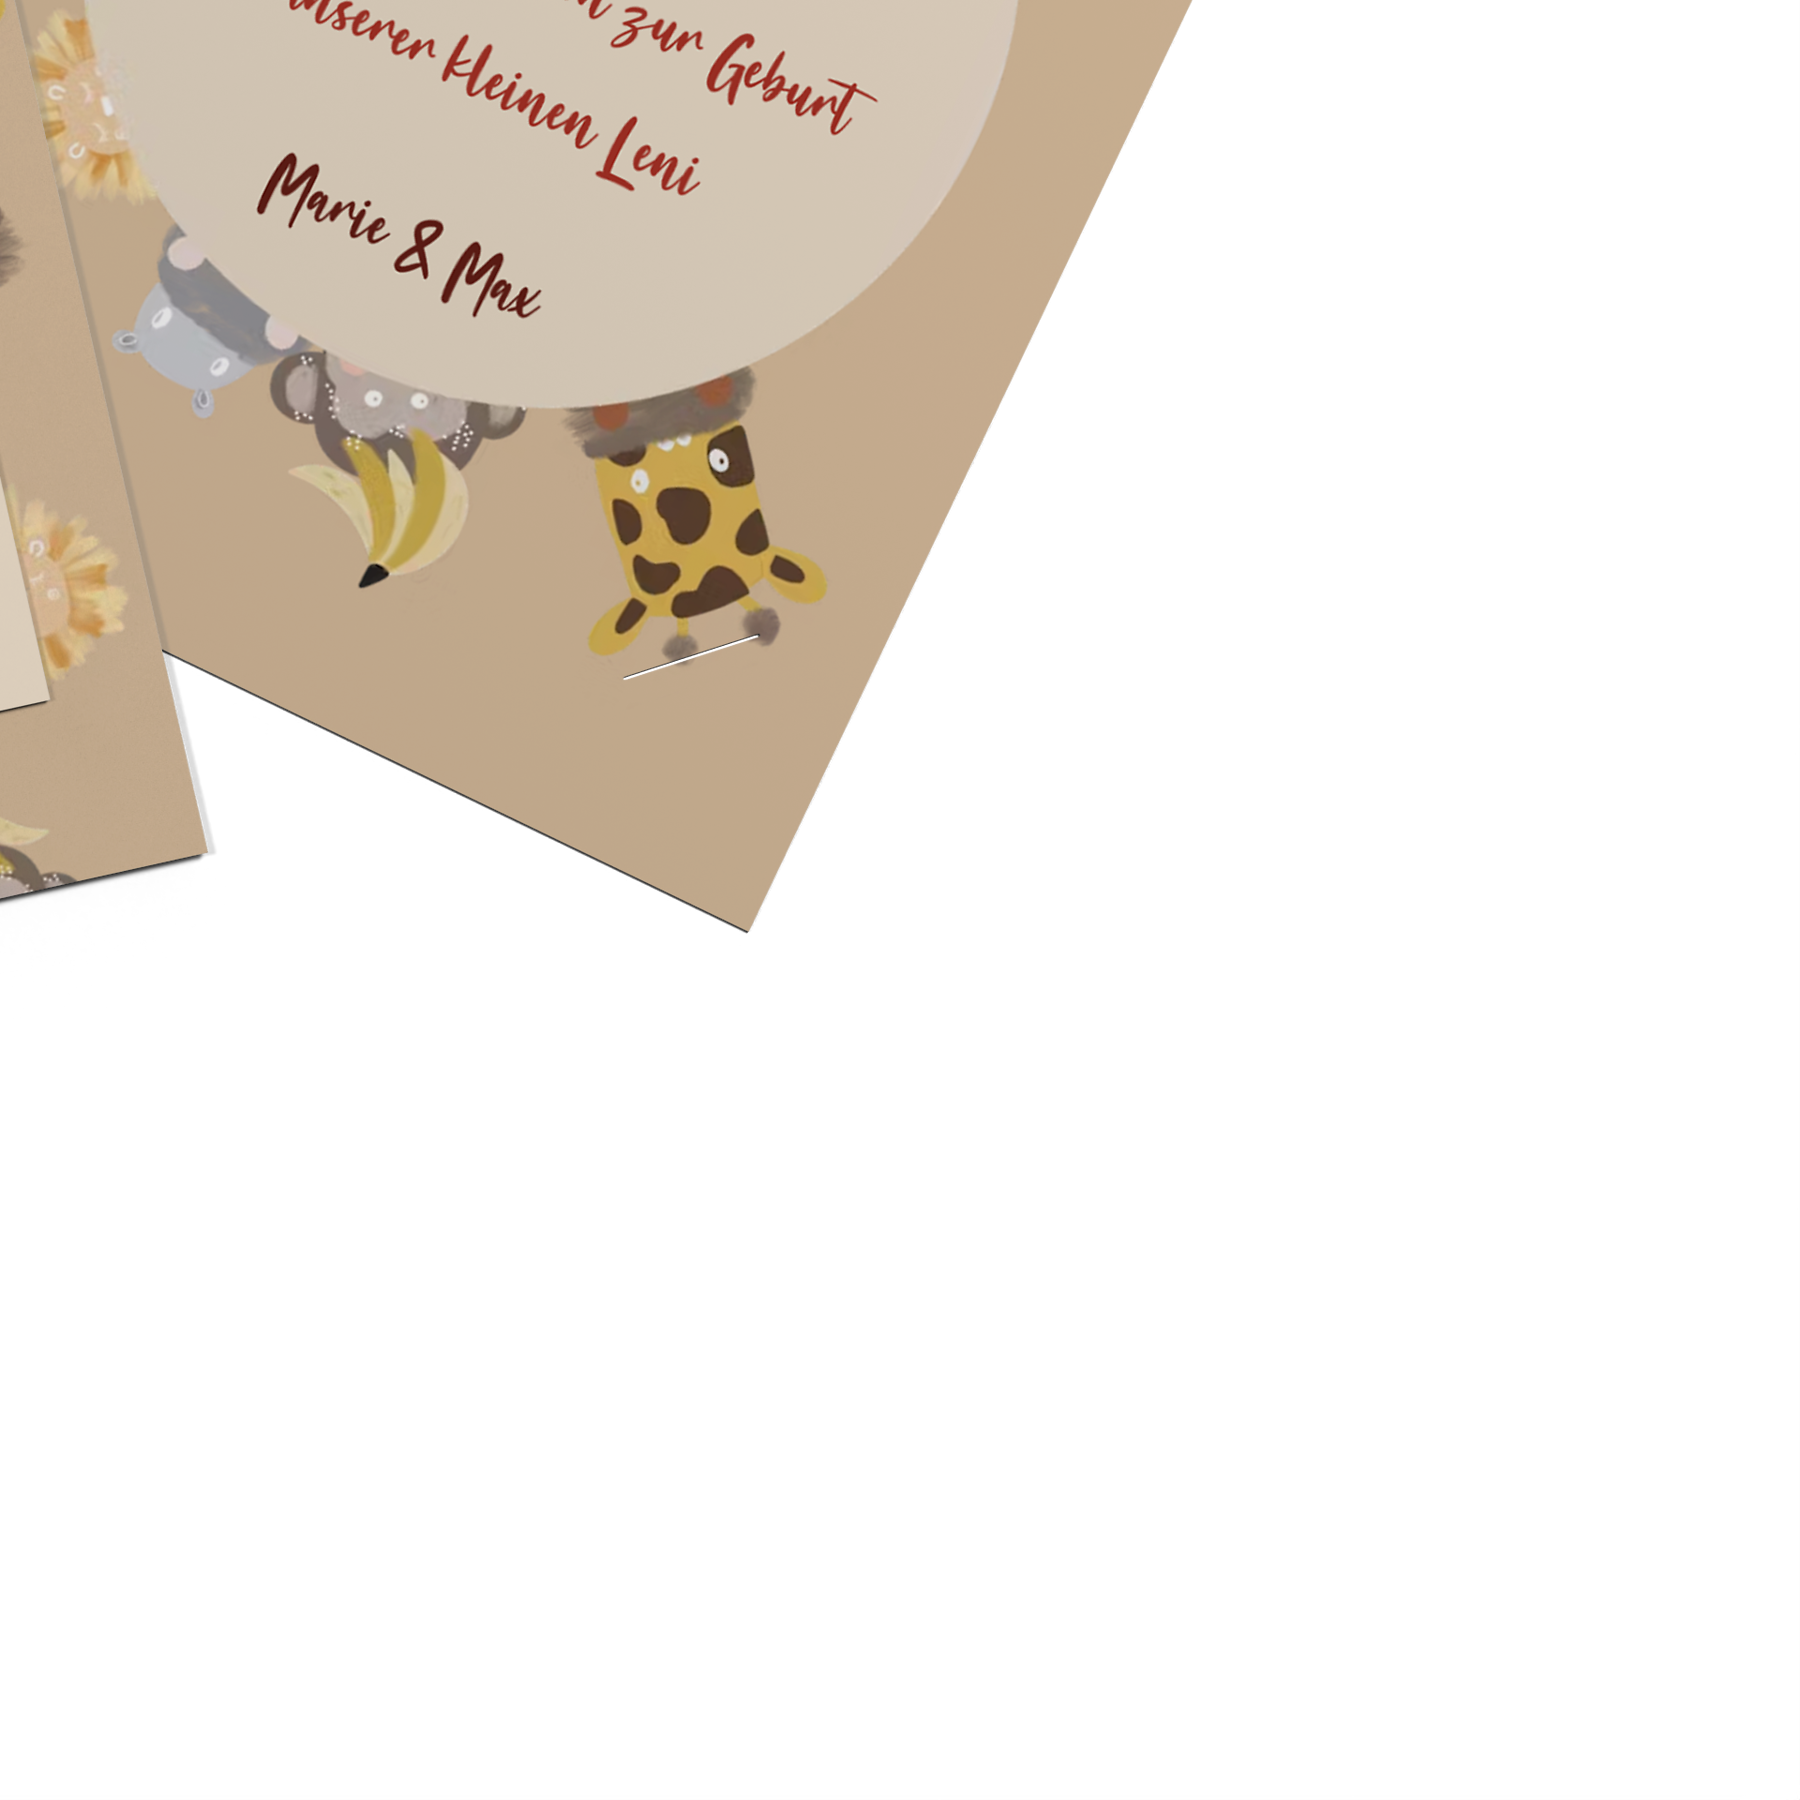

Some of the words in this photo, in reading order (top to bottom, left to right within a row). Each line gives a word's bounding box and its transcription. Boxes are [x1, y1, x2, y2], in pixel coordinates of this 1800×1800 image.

[442, 35, 598, 149] kleinen
[596, 117, 700, 195] Leni
[611, 7, 703, 52] zur
[707, 34, 877, 135] Geburt
[257, 153, 390, 244] Marie
[394, 220, 443, 279] &
[441, 242, 541, 318] Max
